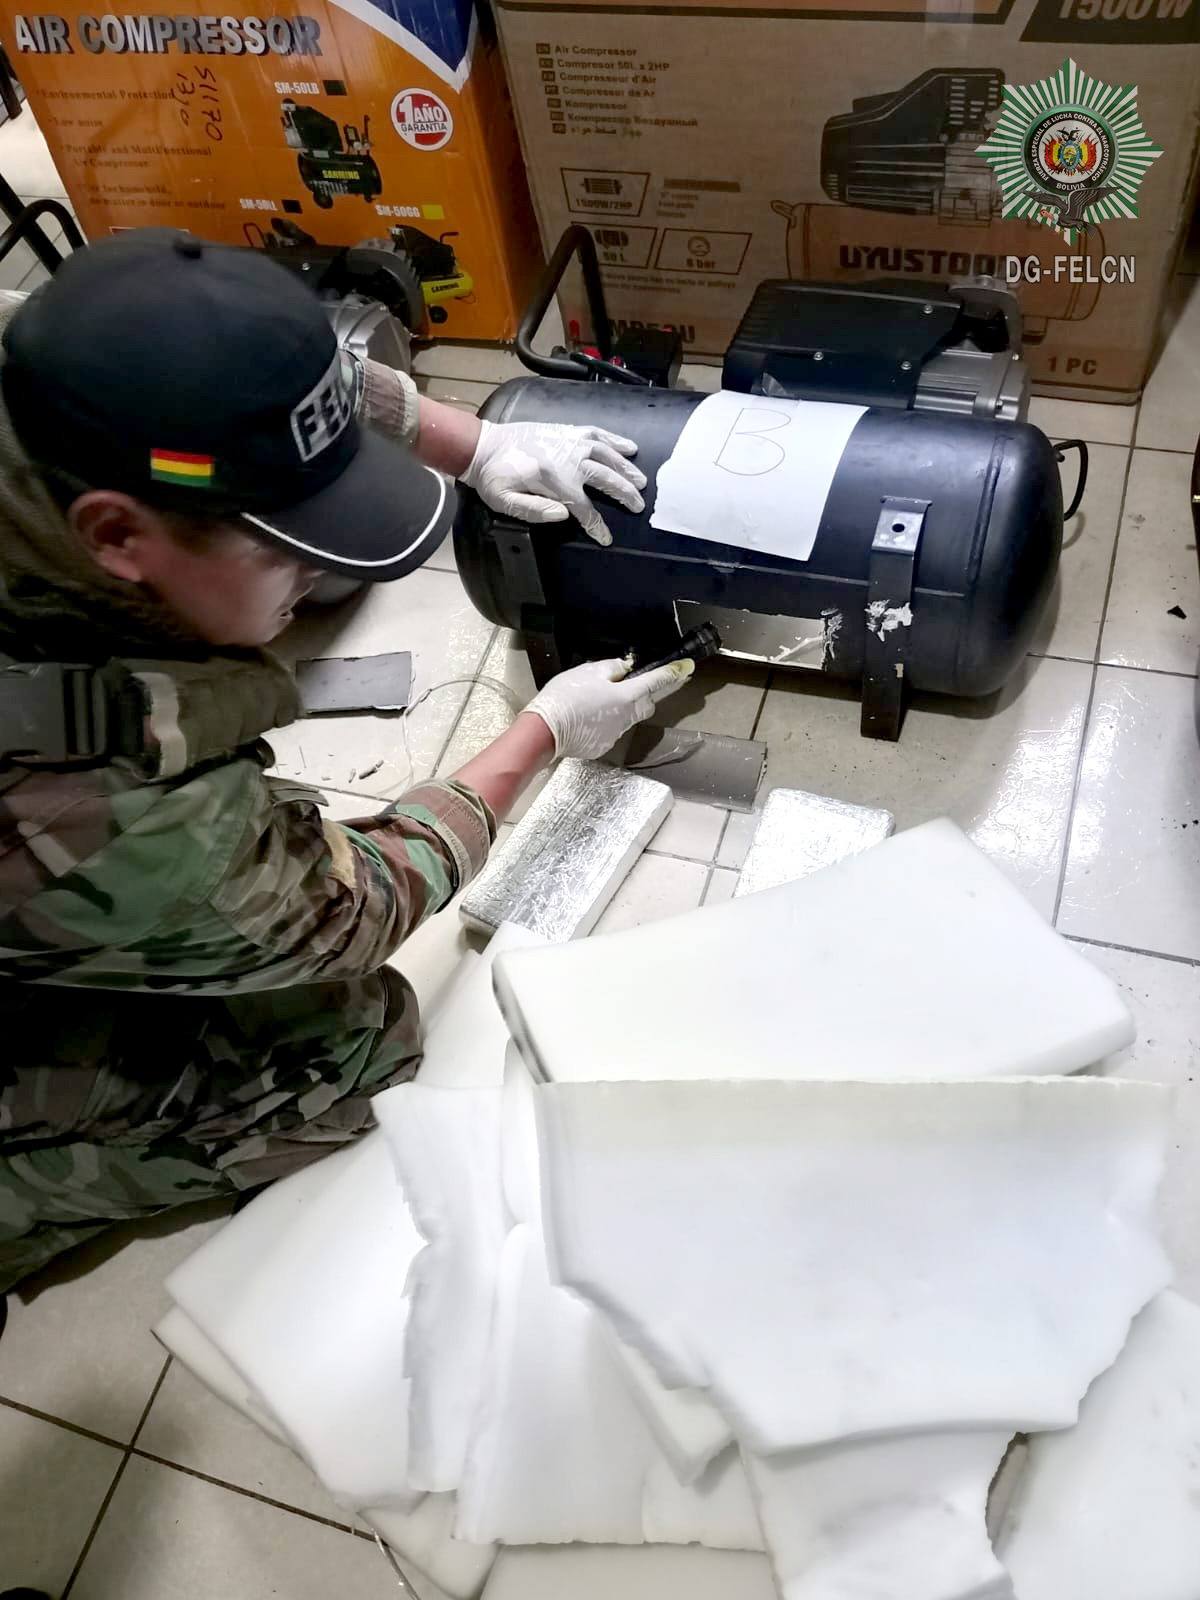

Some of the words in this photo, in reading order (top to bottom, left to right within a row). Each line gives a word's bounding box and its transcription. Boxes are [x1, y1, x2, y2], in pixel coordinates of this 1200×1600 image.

[15, 14, 74, 54] AIR
[78, 15, 323, 56] COMPRESSOR
[572, 45, 637, 57] Compressor
[648, 62, 670, 71] 2HP
[414, 103, 444, 122] AÑO
[1048, 357, 1057, 373] 1
[1065, 359, 1097, 376] PC
[712, 407, 792, 476] B
